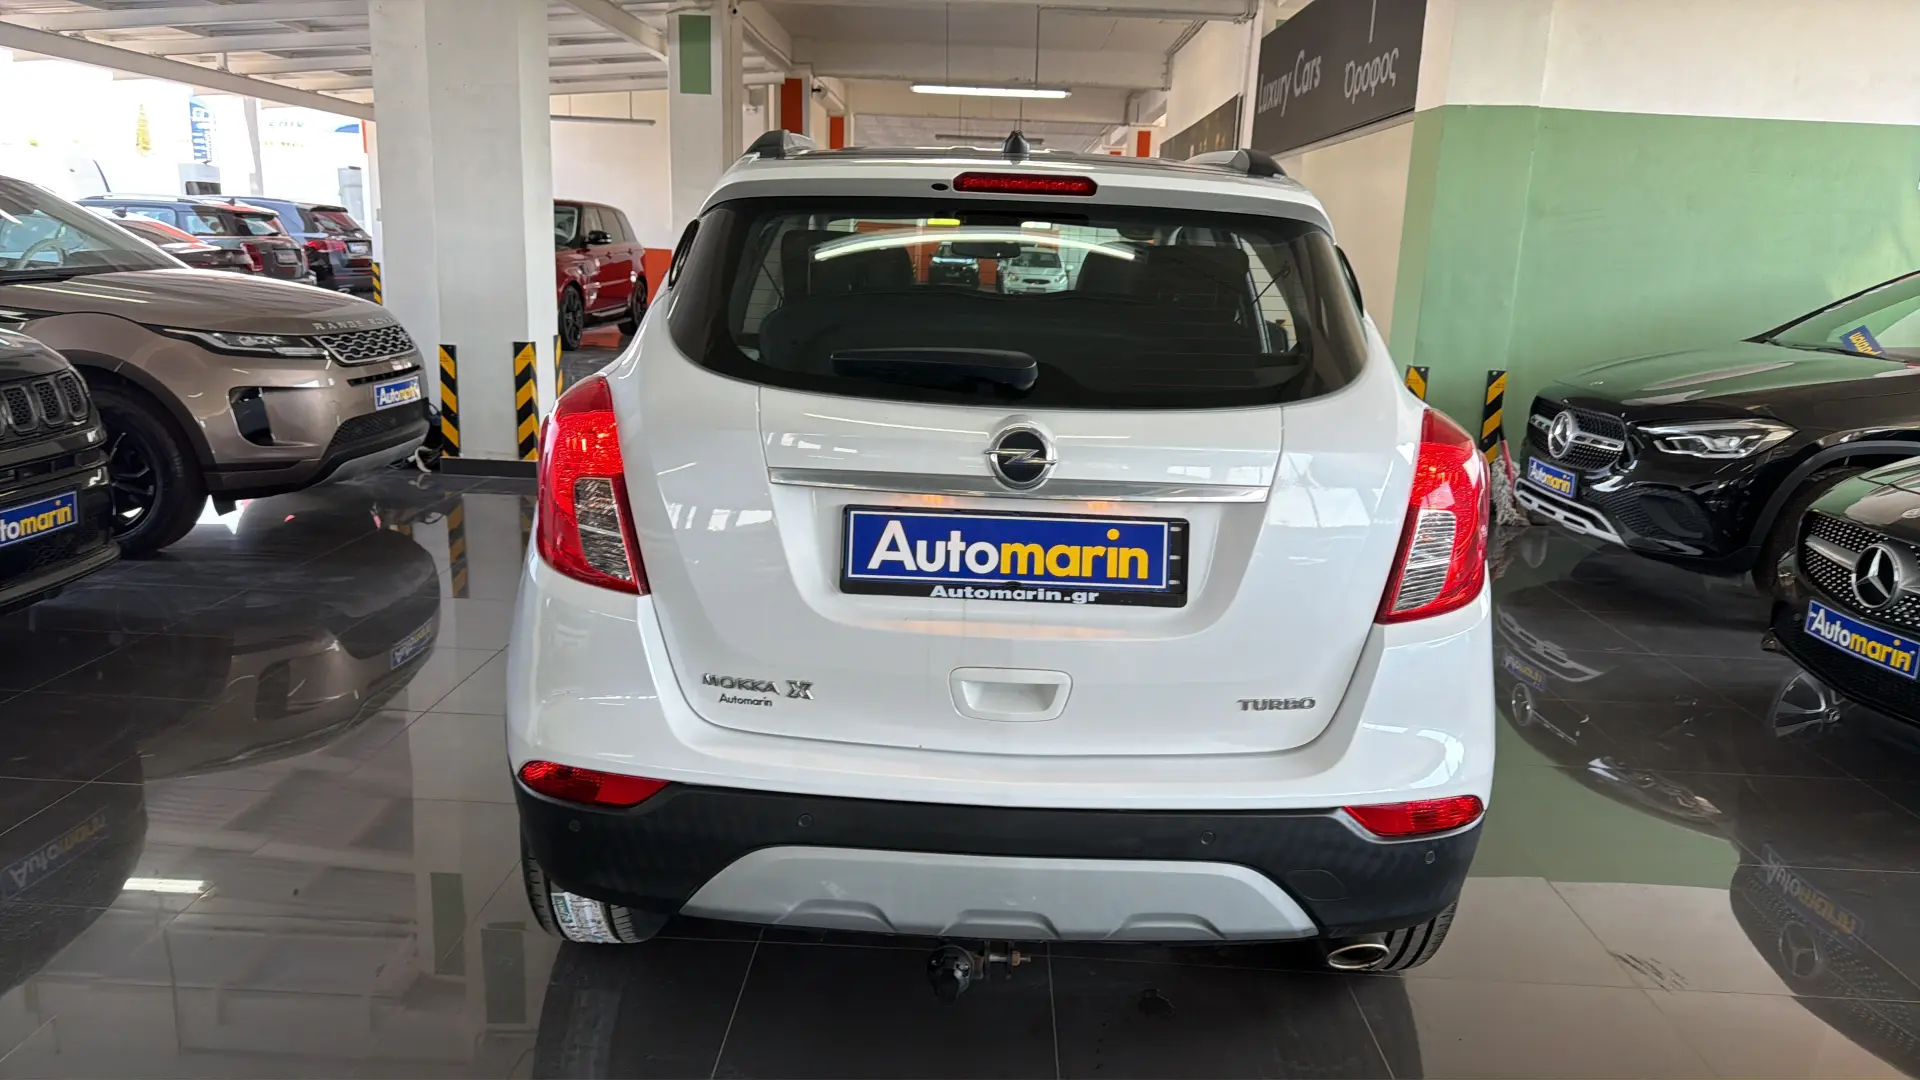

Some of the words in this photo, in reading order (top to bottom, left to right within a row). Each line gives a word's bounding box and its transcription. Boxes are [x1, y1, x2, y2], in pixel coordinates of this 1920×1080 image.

[1257, 72, 1293, 117] Luxury
[1294, 49, 1322, 98] Cars
[312, 320, 365, 331] RANGE
[866, 519, 1150, 579] Automarin
[930, 584, 1099, 604] Automarin.gr
[1810, 608, 1913, 673] Automarin
[701, 673, 781, 695] MOKKA
[785, 679, 815, 701] X
[718, 693, 773, 707] Automarin
[1236, 696, 1316, 712] TURBO
